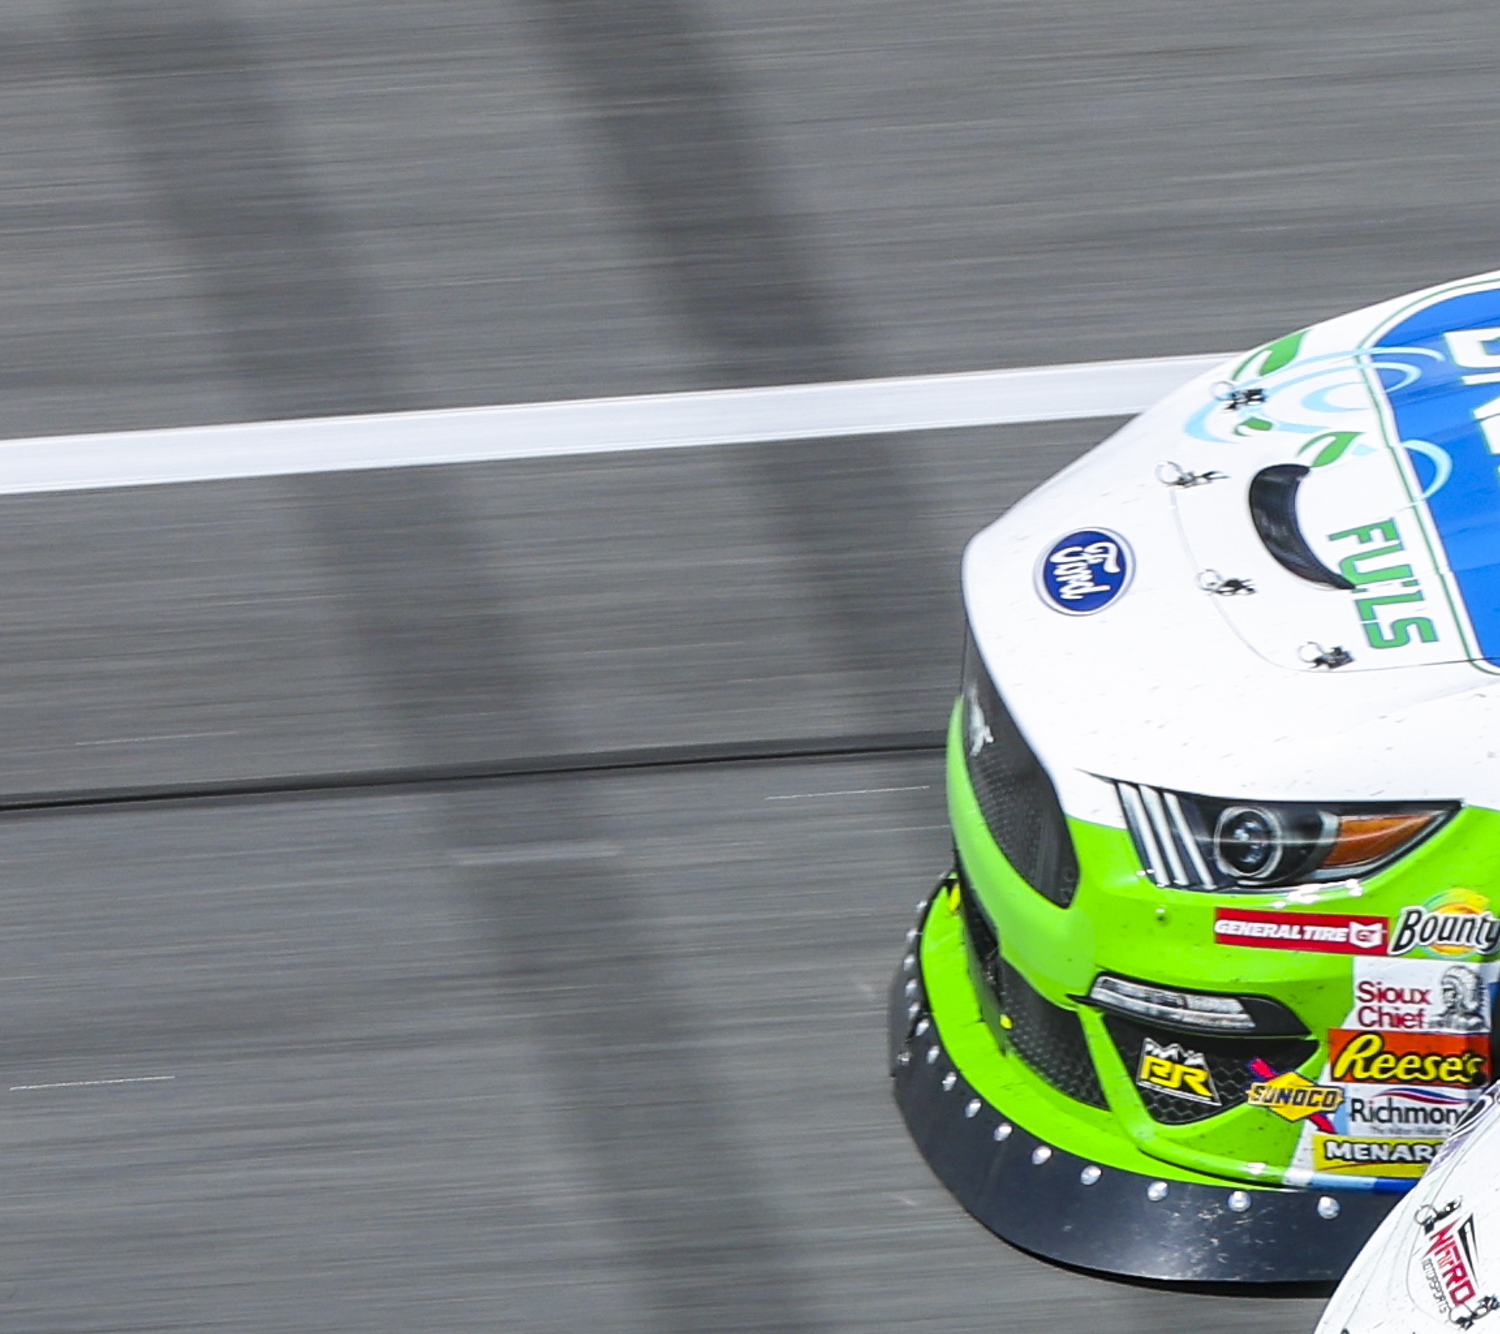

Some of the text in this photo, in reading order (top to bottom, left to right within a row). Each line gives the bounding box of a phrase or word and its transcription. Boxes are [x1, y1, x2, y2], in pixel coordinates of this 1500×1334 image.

[1050, 540, 1120, 599] Ford
[1328, 517, 1440, 650] FULS
[1215, 919, 1348, 943] GENERAL TIRE
[1356, 981, 1432, 1006] Sioux
[1357, 1004, 1426, 1029] Chief
[1333, 1033, 1488, 1084] Reese's
[1249, 1084, 1343, 1113] SUNOCO
[1351, 1097, 1466, 1125] Richmon
[1324, 1139, 1440, 1163] MENAR
[1422, 1216, 1477, 1307] NITRO
